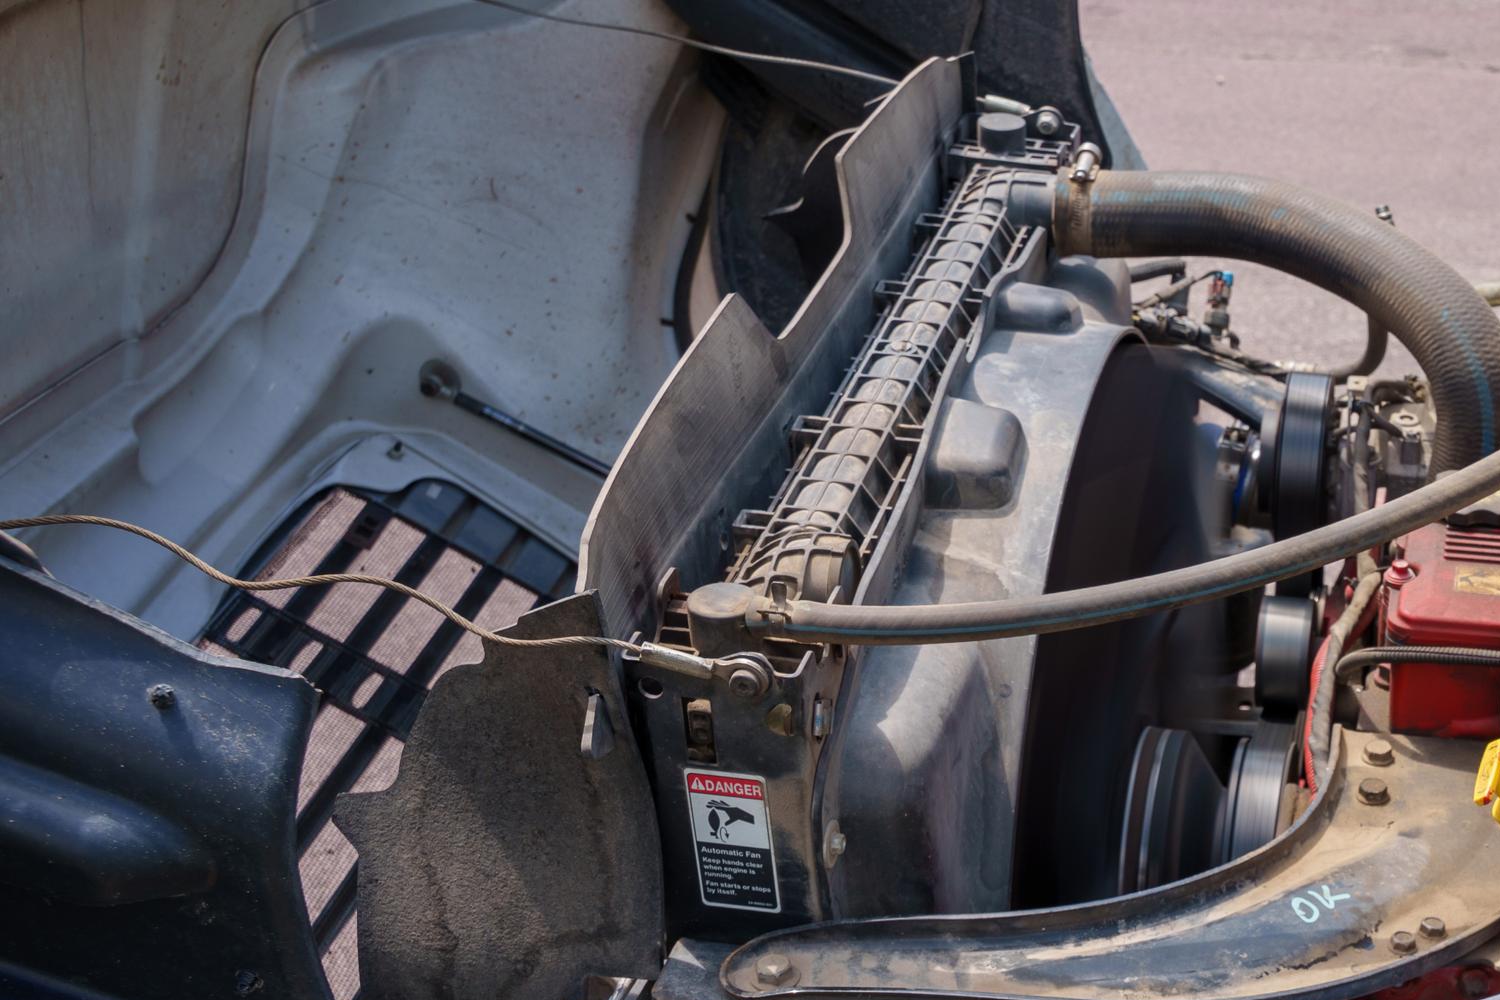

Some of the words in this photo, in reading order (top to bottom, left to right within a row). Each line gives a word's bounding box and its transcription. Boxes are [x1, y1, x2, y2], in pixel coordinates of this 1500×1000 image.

[705, 779, 762, 797] DANGER
[700, 845, 744, 857] Automatic
[701, 856, 720, 864] Keep
[721, 858, 743, 866] hands
[745, 860, 763, 868] clear
[703, 863, 722, 871] when
[723, 866, 748, 874] engine
[704, 870, 733, 879] running.
[706, 886, 715, 894] by
[716, 887, 737, 895] itself.
[720, 881, 741, 889] starts
[751, 885, 771, 893] stops
[1291, 885, 1351, 923] OK
